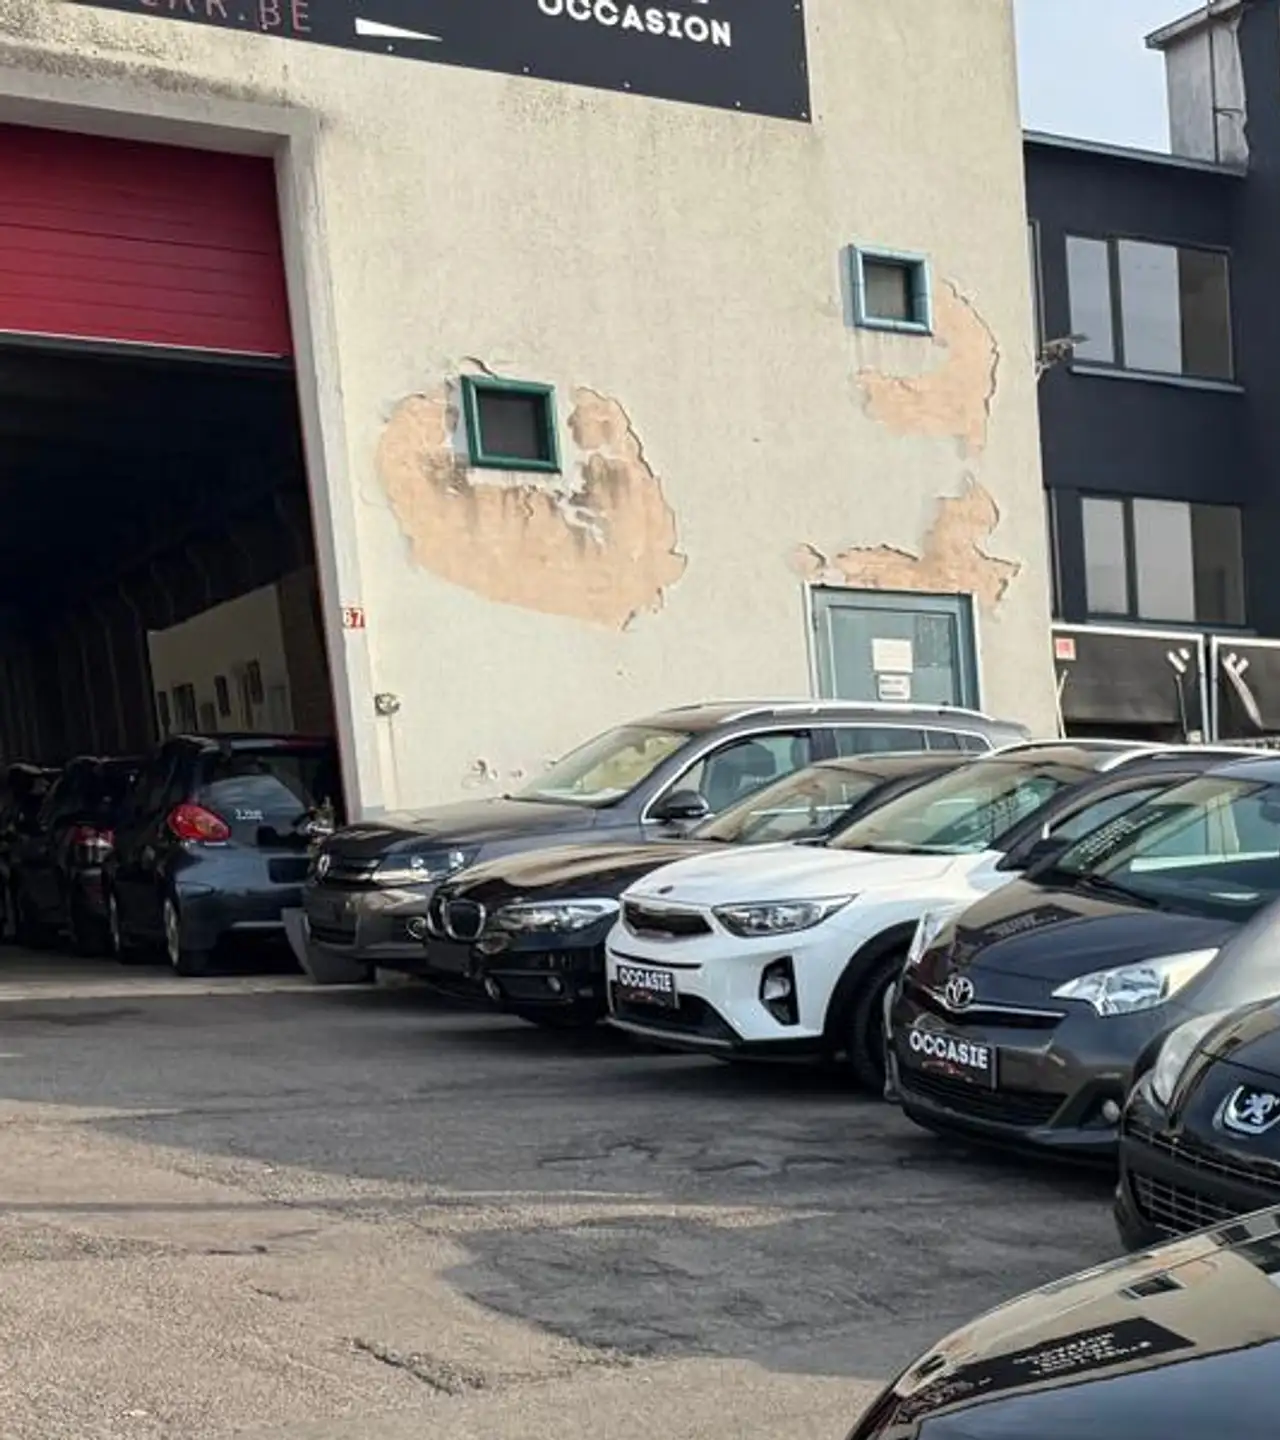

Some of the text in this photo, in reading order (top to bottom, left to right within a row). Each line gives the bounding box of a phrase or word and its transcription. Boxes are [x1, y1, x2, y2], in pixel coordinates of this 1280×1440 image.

[537, 0, 731, 47] OCCASION
[342, 608, 364, 629] 67
[619, 967, 673, 993] OCCASIE
[908, 1029, 989, 1070] OCCASIE
